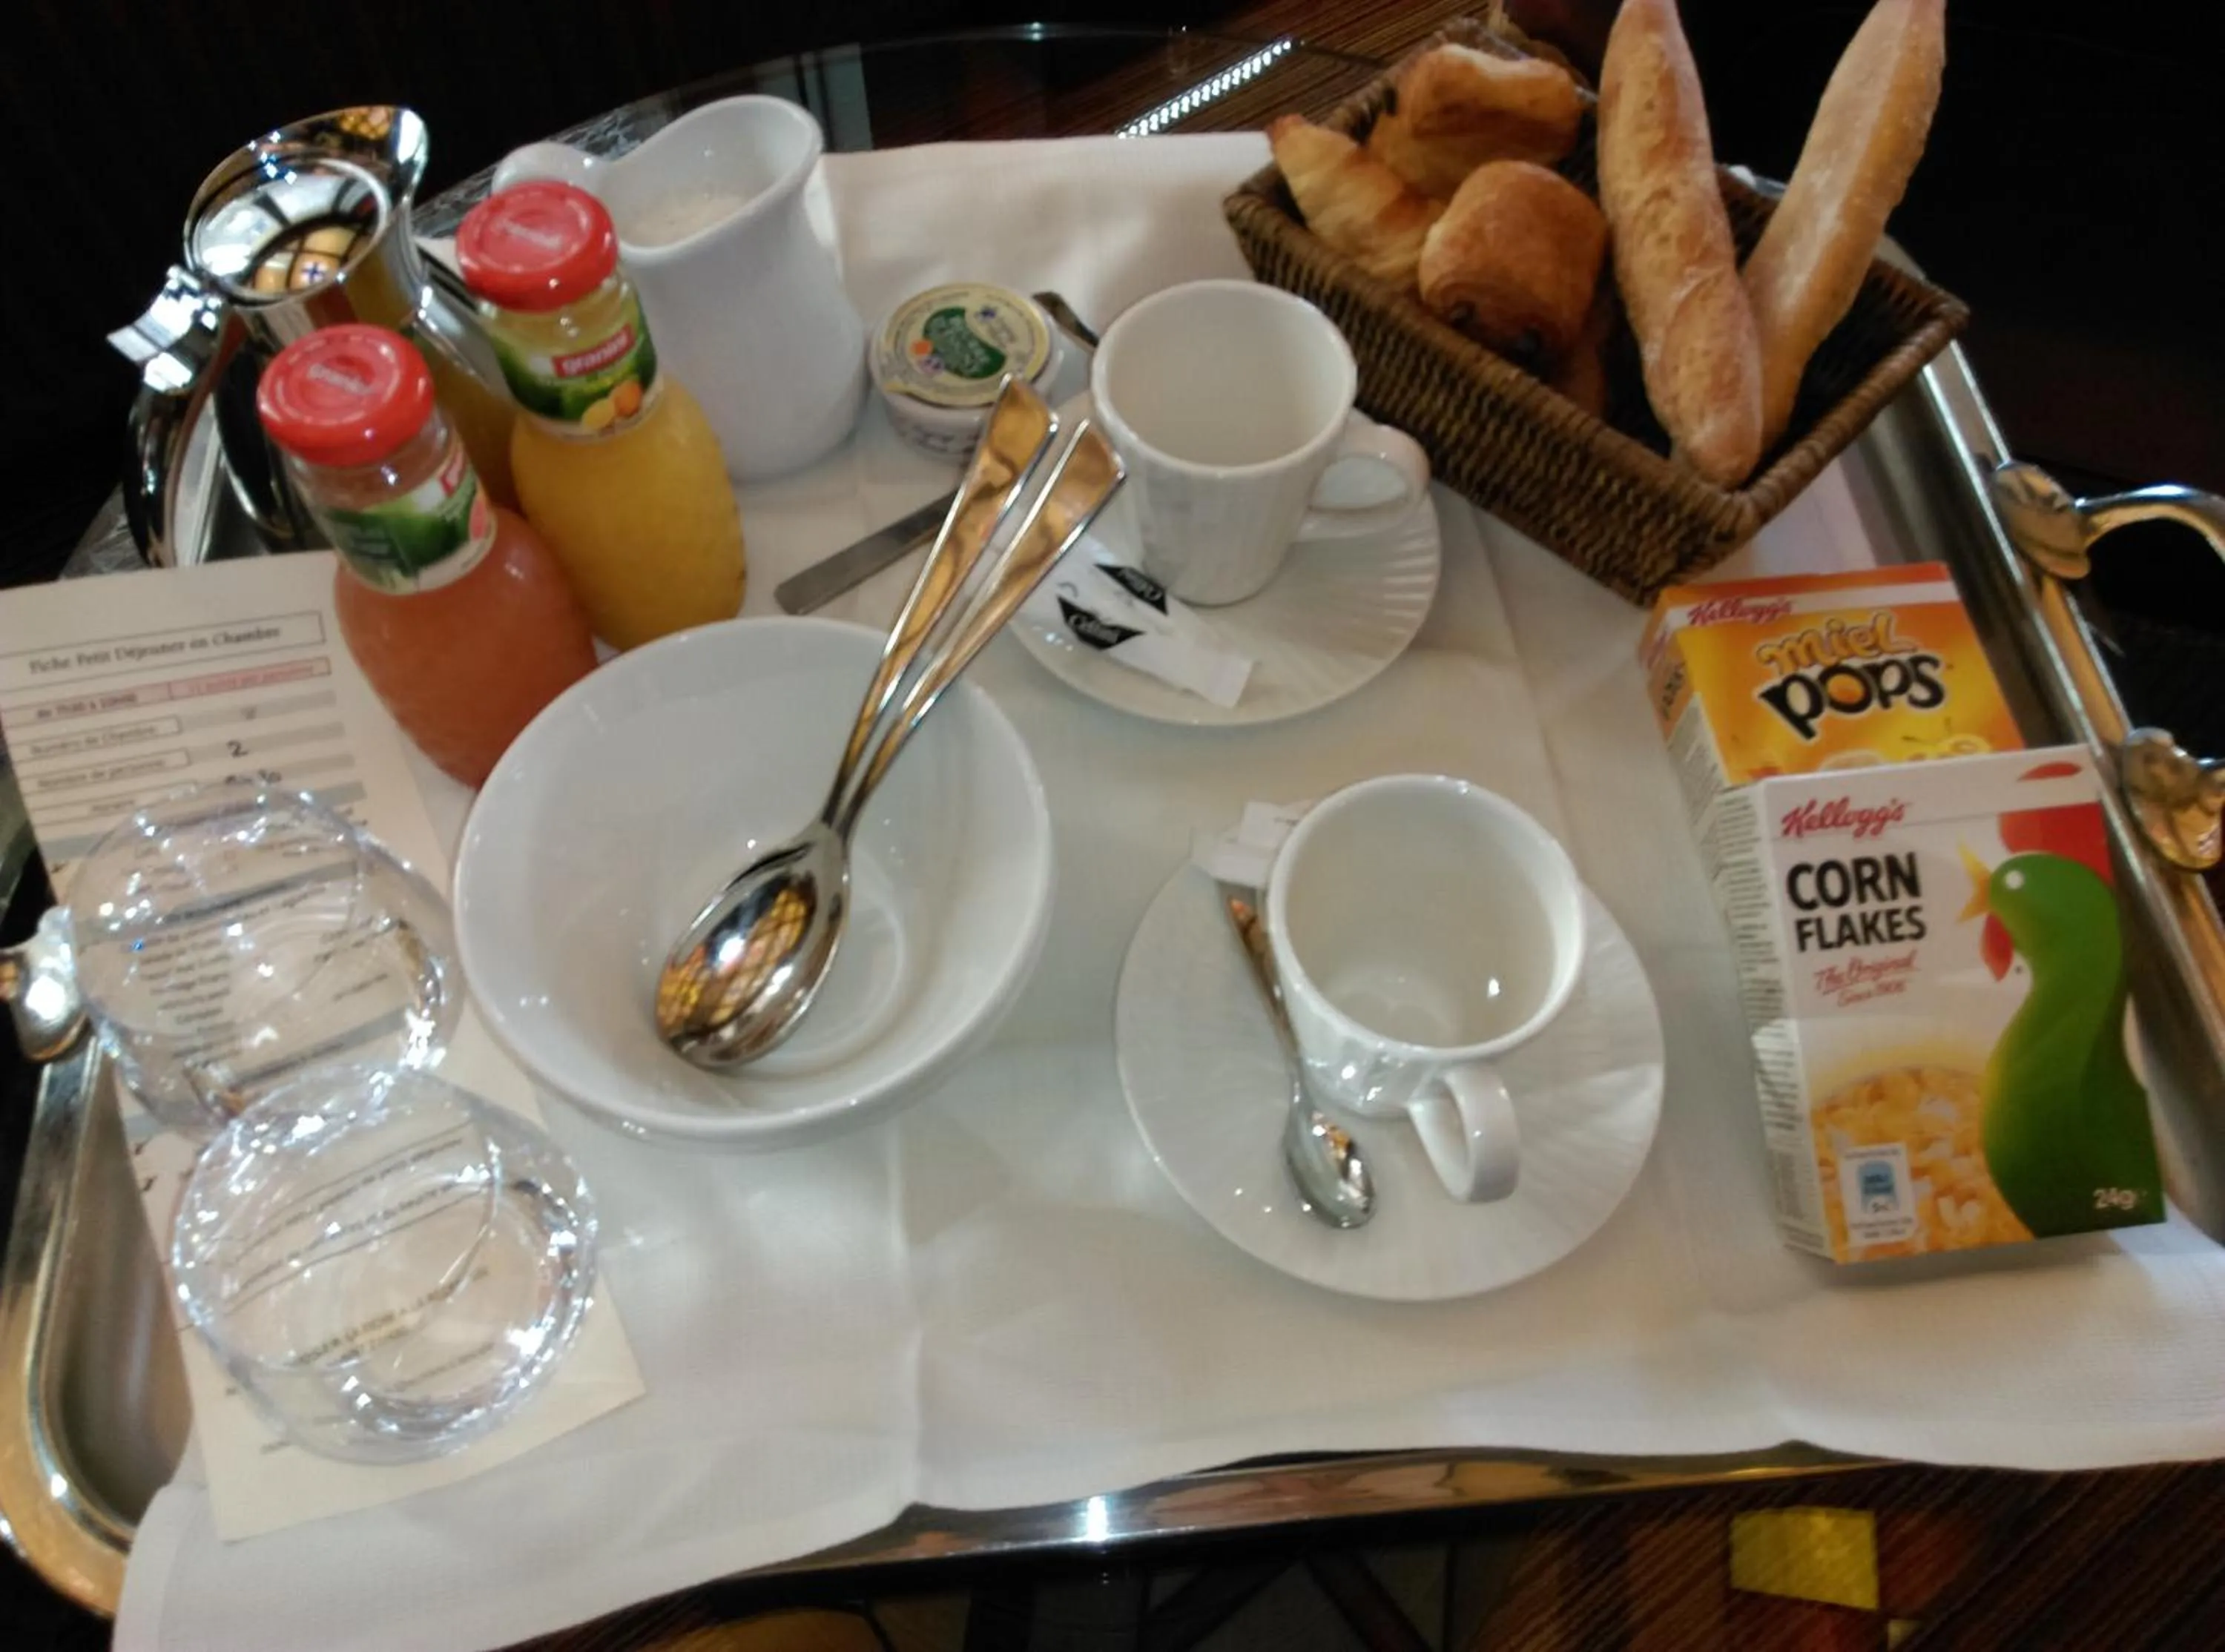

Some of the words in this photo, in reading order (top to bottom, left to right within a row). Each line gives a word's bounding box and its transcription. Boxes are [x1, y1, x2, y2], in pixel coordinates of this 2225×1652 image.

[1687, 598, 1793, 627] Kellogg's
[212, 627, 280, 647] Chambre
[226, 739, 248, 759] 2
[1781, 797, 1909, 839] Kellogg's
[1786, 851, 1922, 911] CORN
[1796, 905, 1927, 954] FLAKES
[1847, 948, 1918, 983] Original
